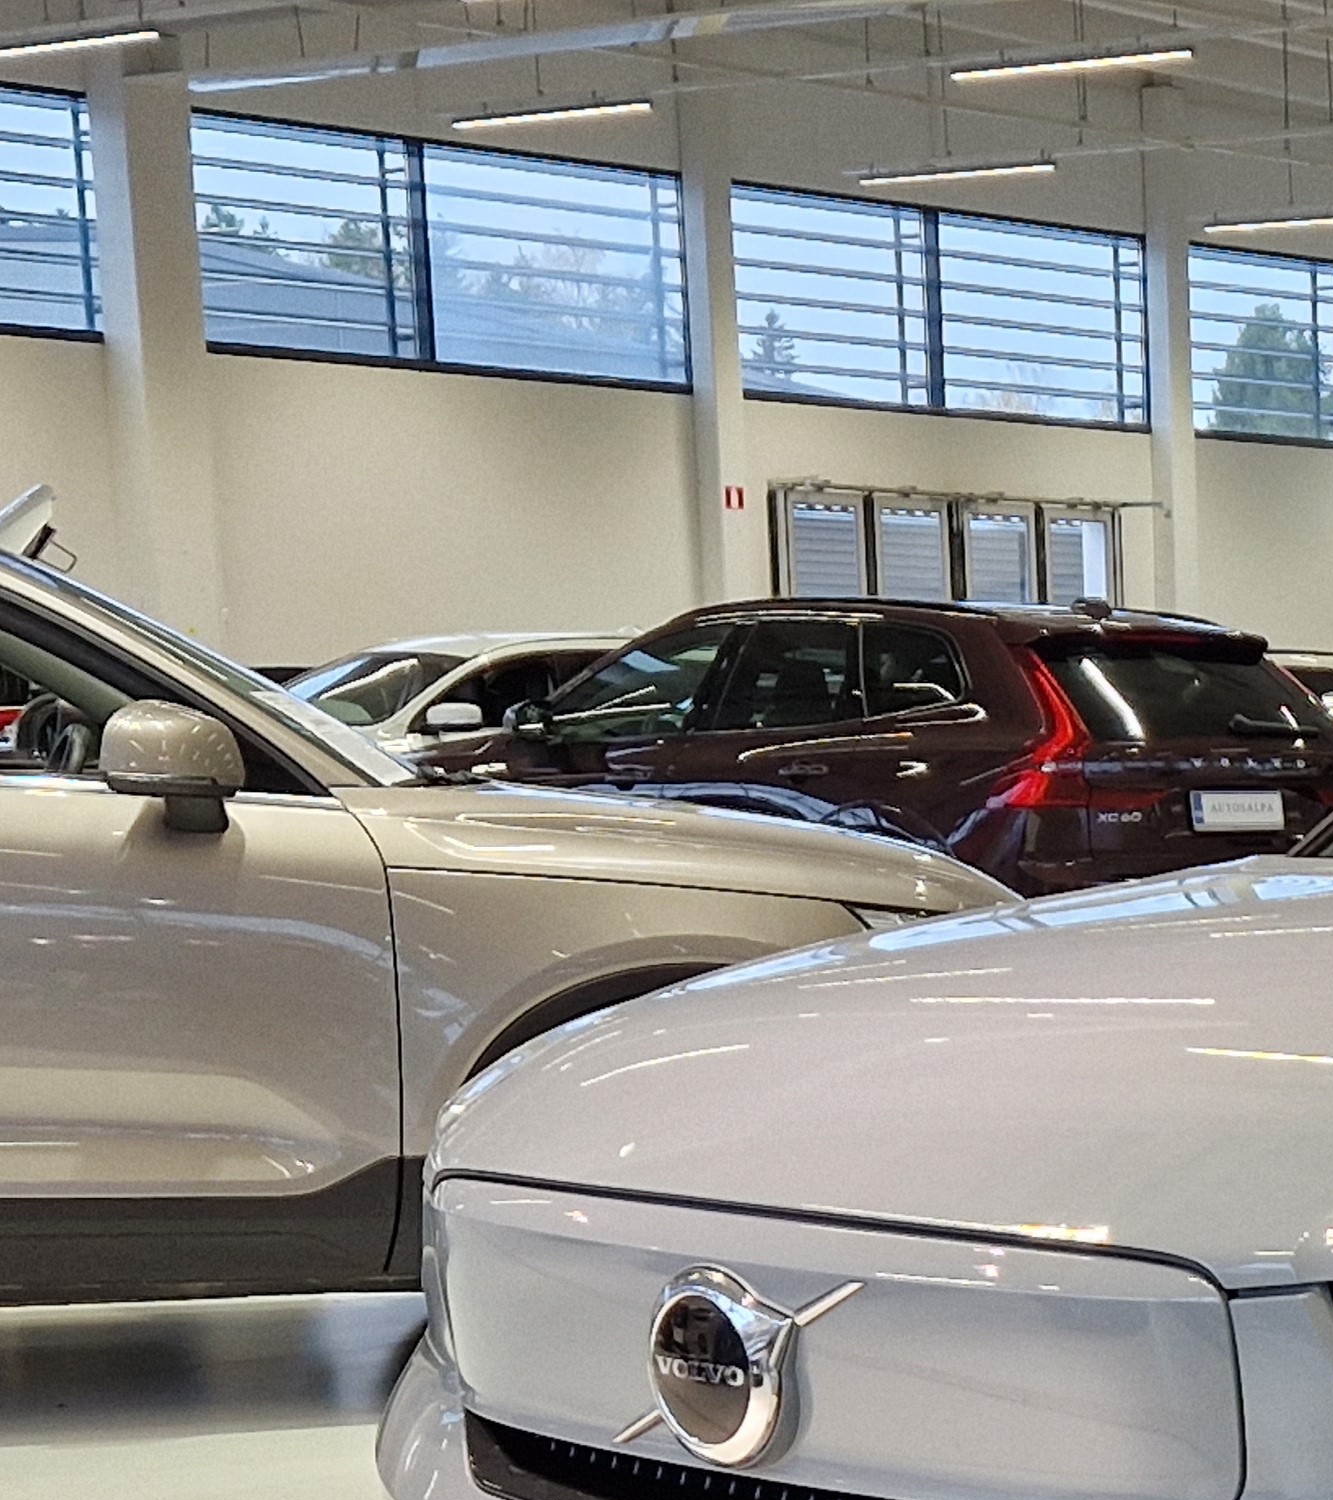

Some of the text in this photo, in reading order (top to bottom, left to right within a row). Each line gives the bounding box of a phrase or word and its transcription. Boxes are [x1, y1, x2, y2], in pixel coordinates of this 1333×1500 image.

[1191, 757, 1306, 769] VOLVO
[1210, 801, 1274, 813] AUTOSALPA
[656, 1355, 745, 1388] VOLVO
